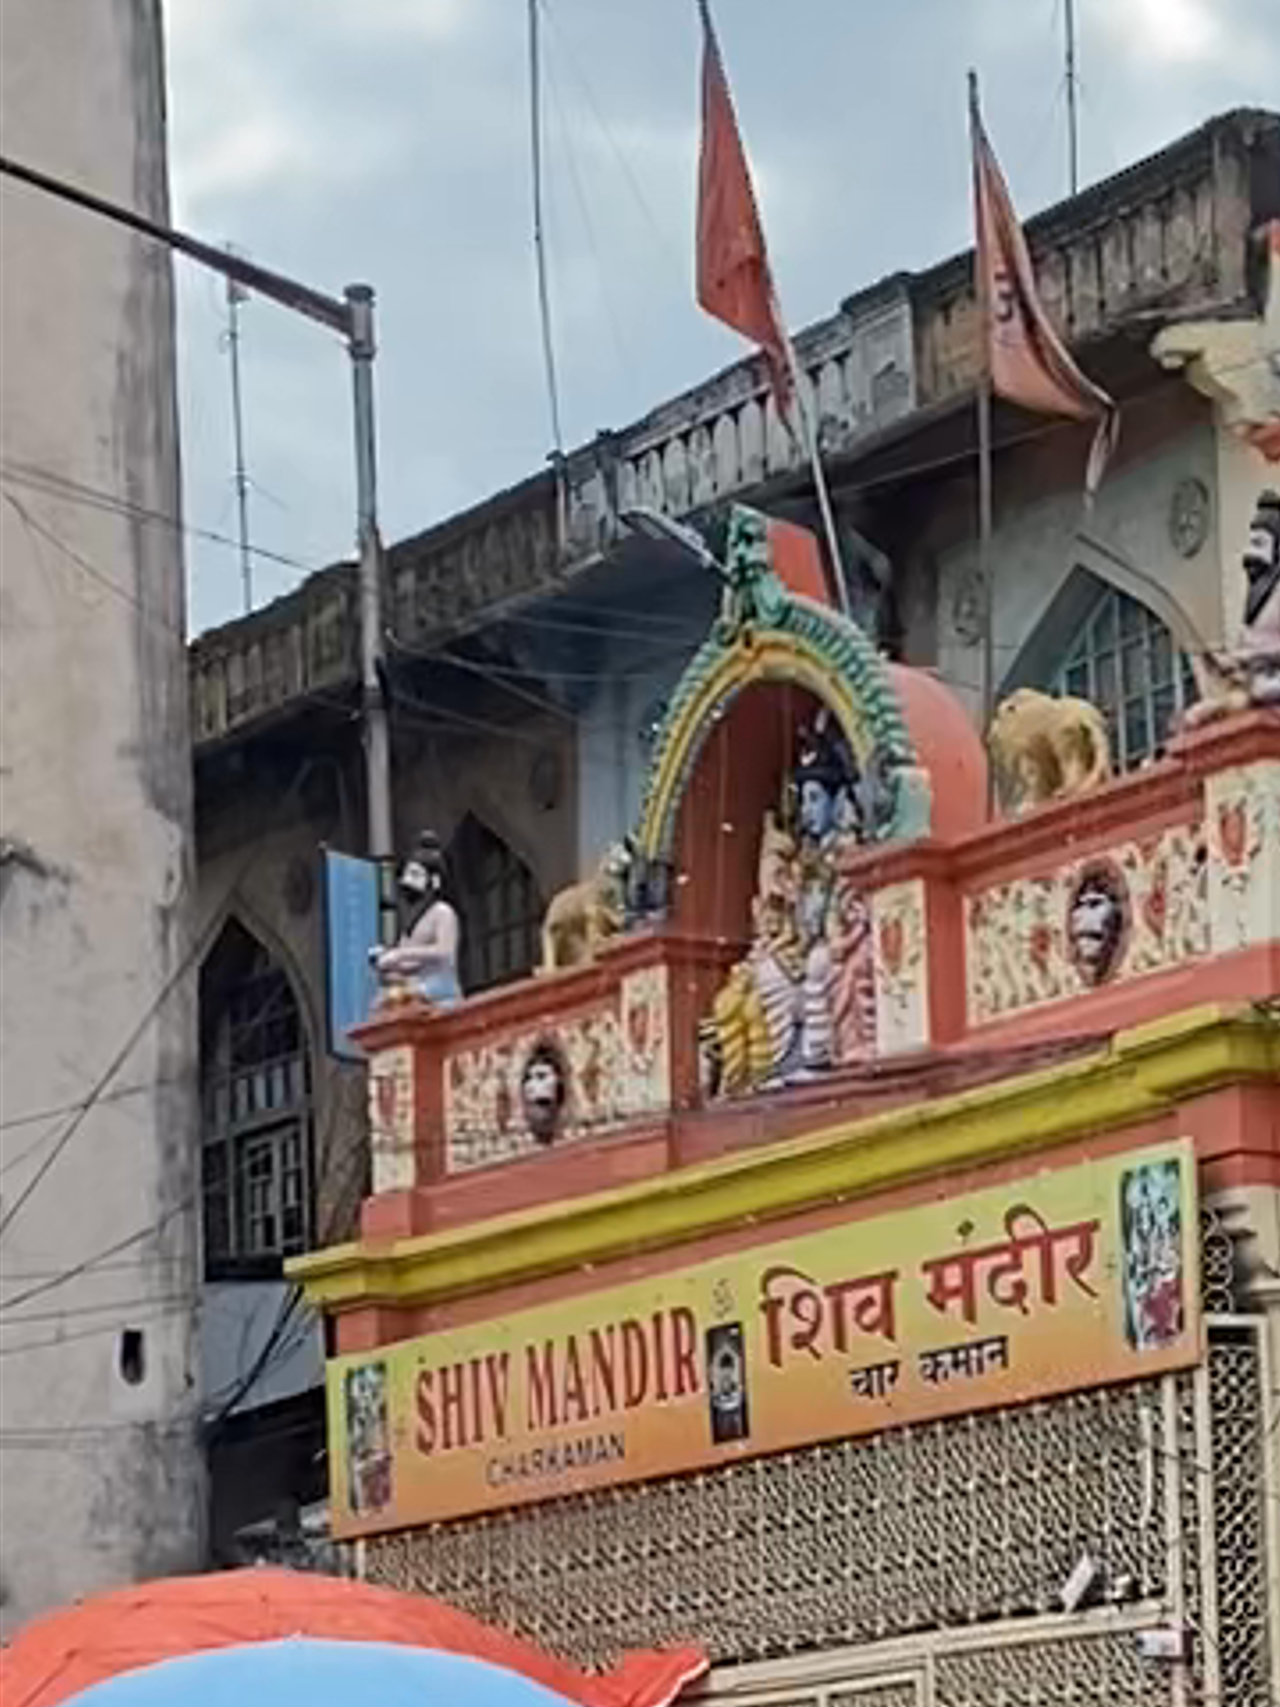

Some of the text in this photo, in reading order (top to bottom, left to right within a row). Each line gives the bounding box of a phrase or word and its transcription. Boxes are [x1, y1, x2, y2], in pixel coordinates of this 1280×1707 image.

[758, 1203, 1101, 1368] शिव मंदीर
[415, 1305, 700, 1456] SHIV MANDIR
[848, 1334, 1010, 1406] चार कमान
[486, 1431, 627, 1488] CHARKAMAN
